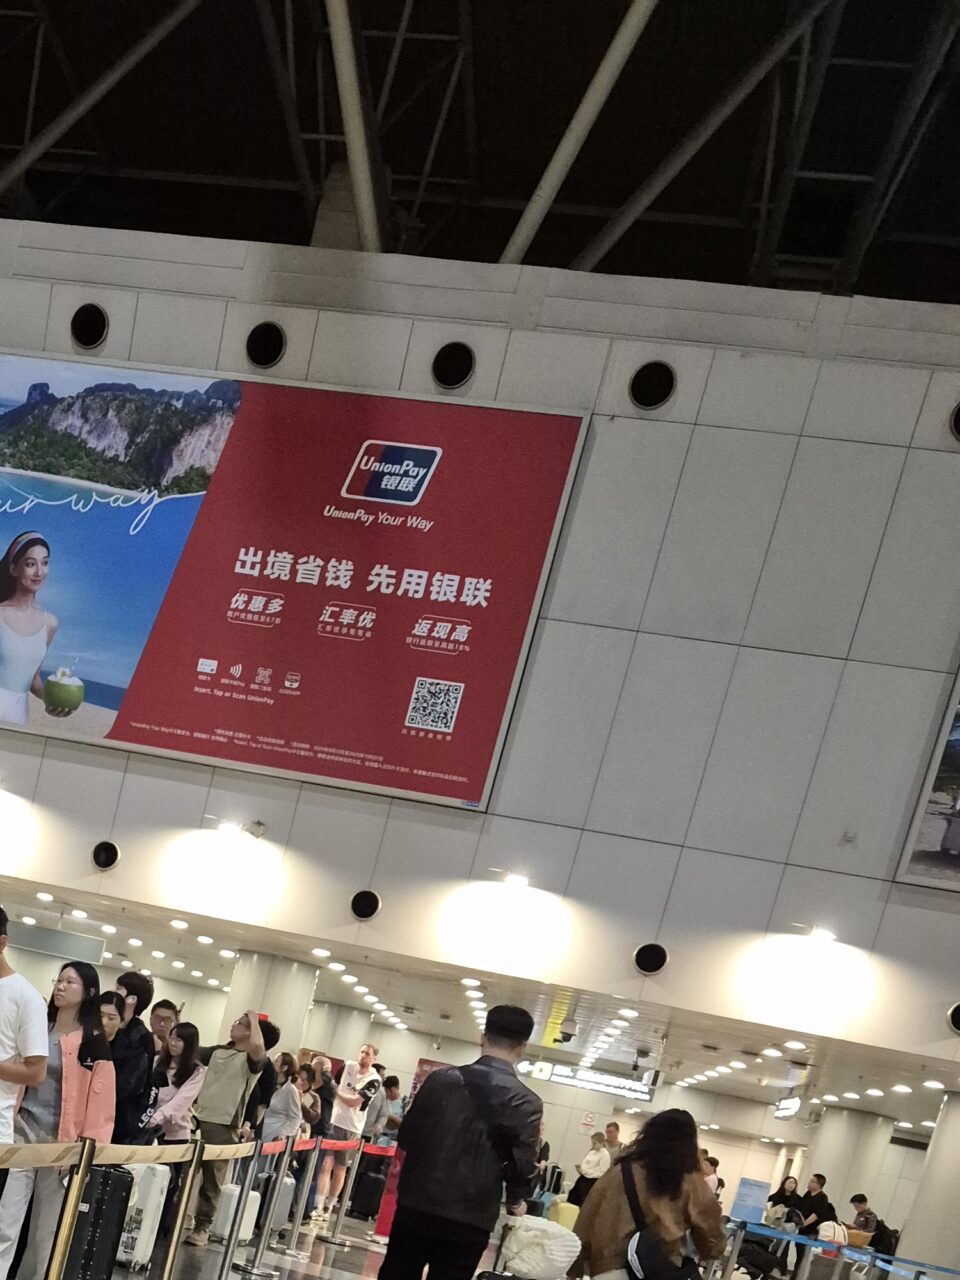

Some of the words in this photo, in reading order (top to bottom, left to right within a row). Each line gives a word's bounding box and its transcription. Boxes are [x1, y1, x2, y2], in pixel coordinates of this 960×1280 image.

[359, 455, 428, 481] UnionPay
[381, 474, 418, 493] 银联
[71, 487, 206, 535] way
[323, 504, 376, 527] UnionPay
[377, 511, 406, 526] Your
[407, 515, 435, 532] Way
[234, 546, 354, 590] 出境省钱
[366, 564, 493, 608] 先用银联
[229, 592, 285, 614] 优惠多
[318, 605, 377, 628] 汇率优
[411, 619, 473, 642] 返现高
